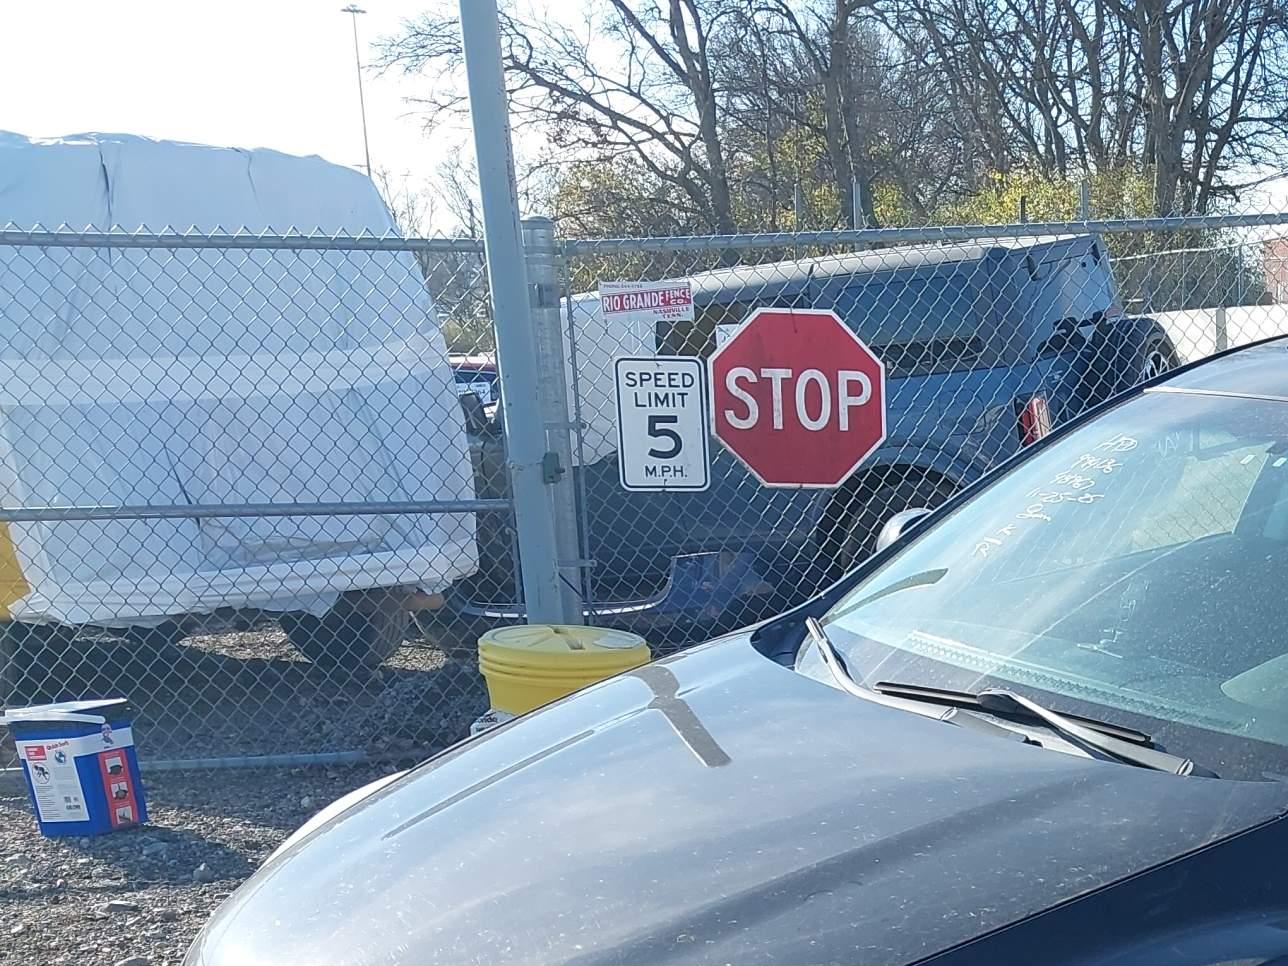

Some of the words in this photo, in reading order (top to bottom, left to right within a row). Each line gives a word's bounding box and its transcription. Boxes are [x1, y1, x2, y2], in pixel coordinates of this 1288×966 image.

[602, 296, 620, 312] RIO
[623, 292, 665, 309] GRANDE
[665, 288, 691, 301] FENCE
[625, 372, 695, 388] SPEED
[634, 392, 689, 408] LIMIT
[724, 367, 873, 432] STOP
[647, 415, 683, 460] 5
[644, 465, 688, 478] M.P.H.
